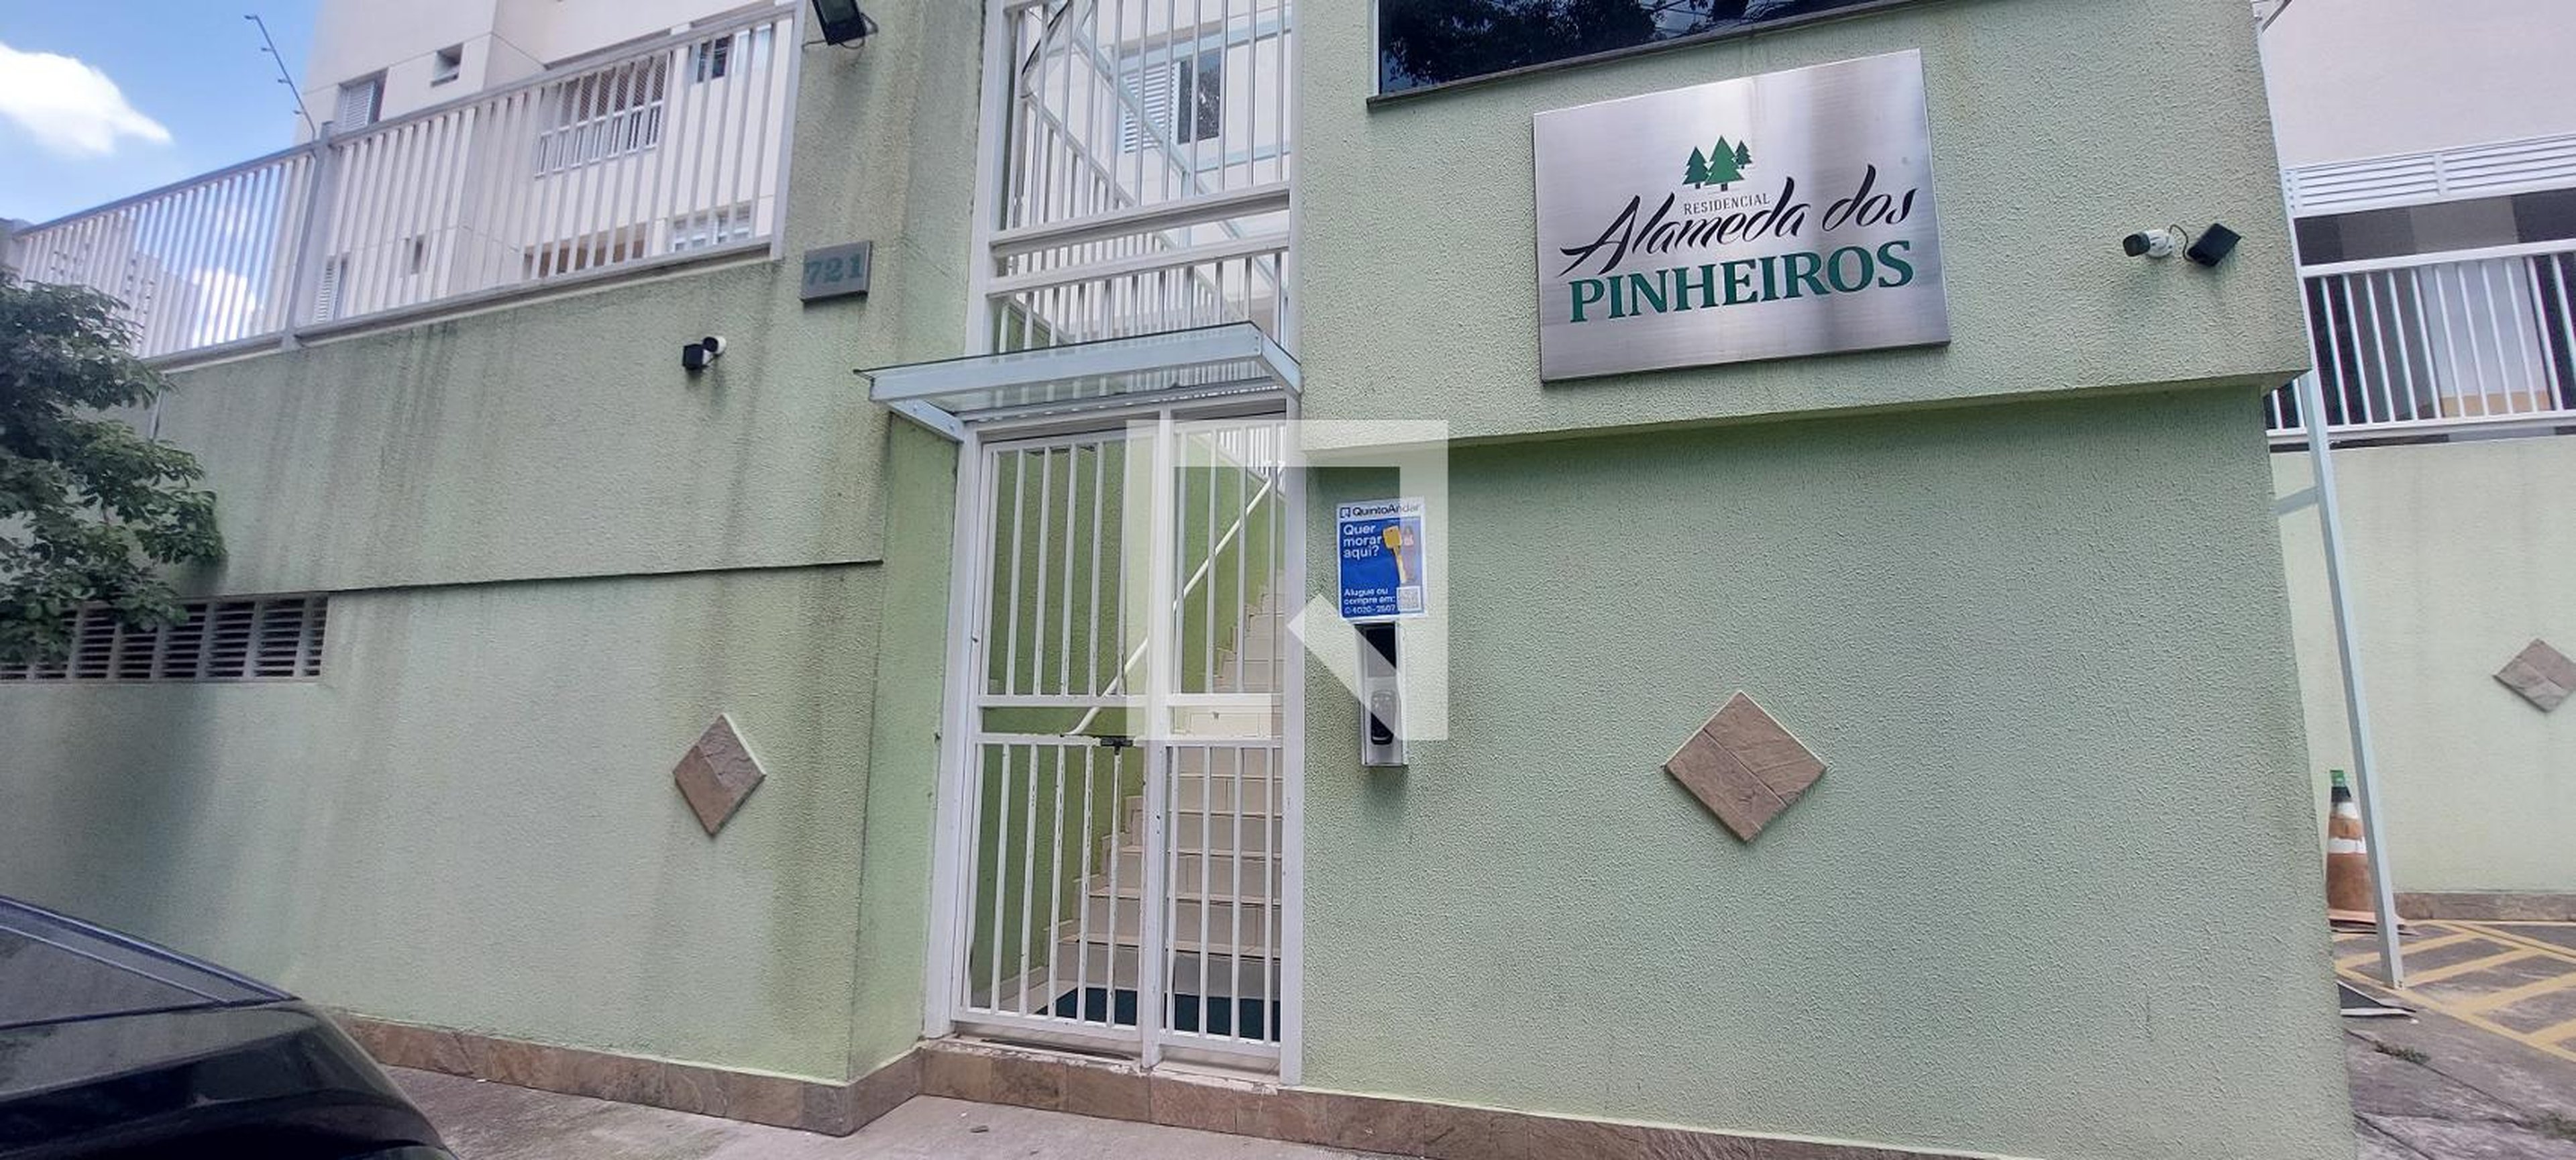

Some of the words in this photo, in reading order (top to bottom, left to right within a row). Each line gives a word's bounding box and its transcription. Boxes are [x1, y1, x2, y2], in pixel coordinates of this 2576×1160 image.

[1684, 193, 1770, 215] RESIDENCIAL
[1559, 176, 1811, 278] Alameda
[1822, 163, 1919, 232] dos
[805, 254, 863, 286] 721
[1568, 240, 1915, 323] PINHEIROS
[1352, 503, 1419, 517] QuintoAndar
[1343, 524, 1377, 535] Quer
[1343, 536, 1382, 547] morar
[1343, 545, 1379, 560] aqui?
[1344, 588, 1375, 597] Alugue
